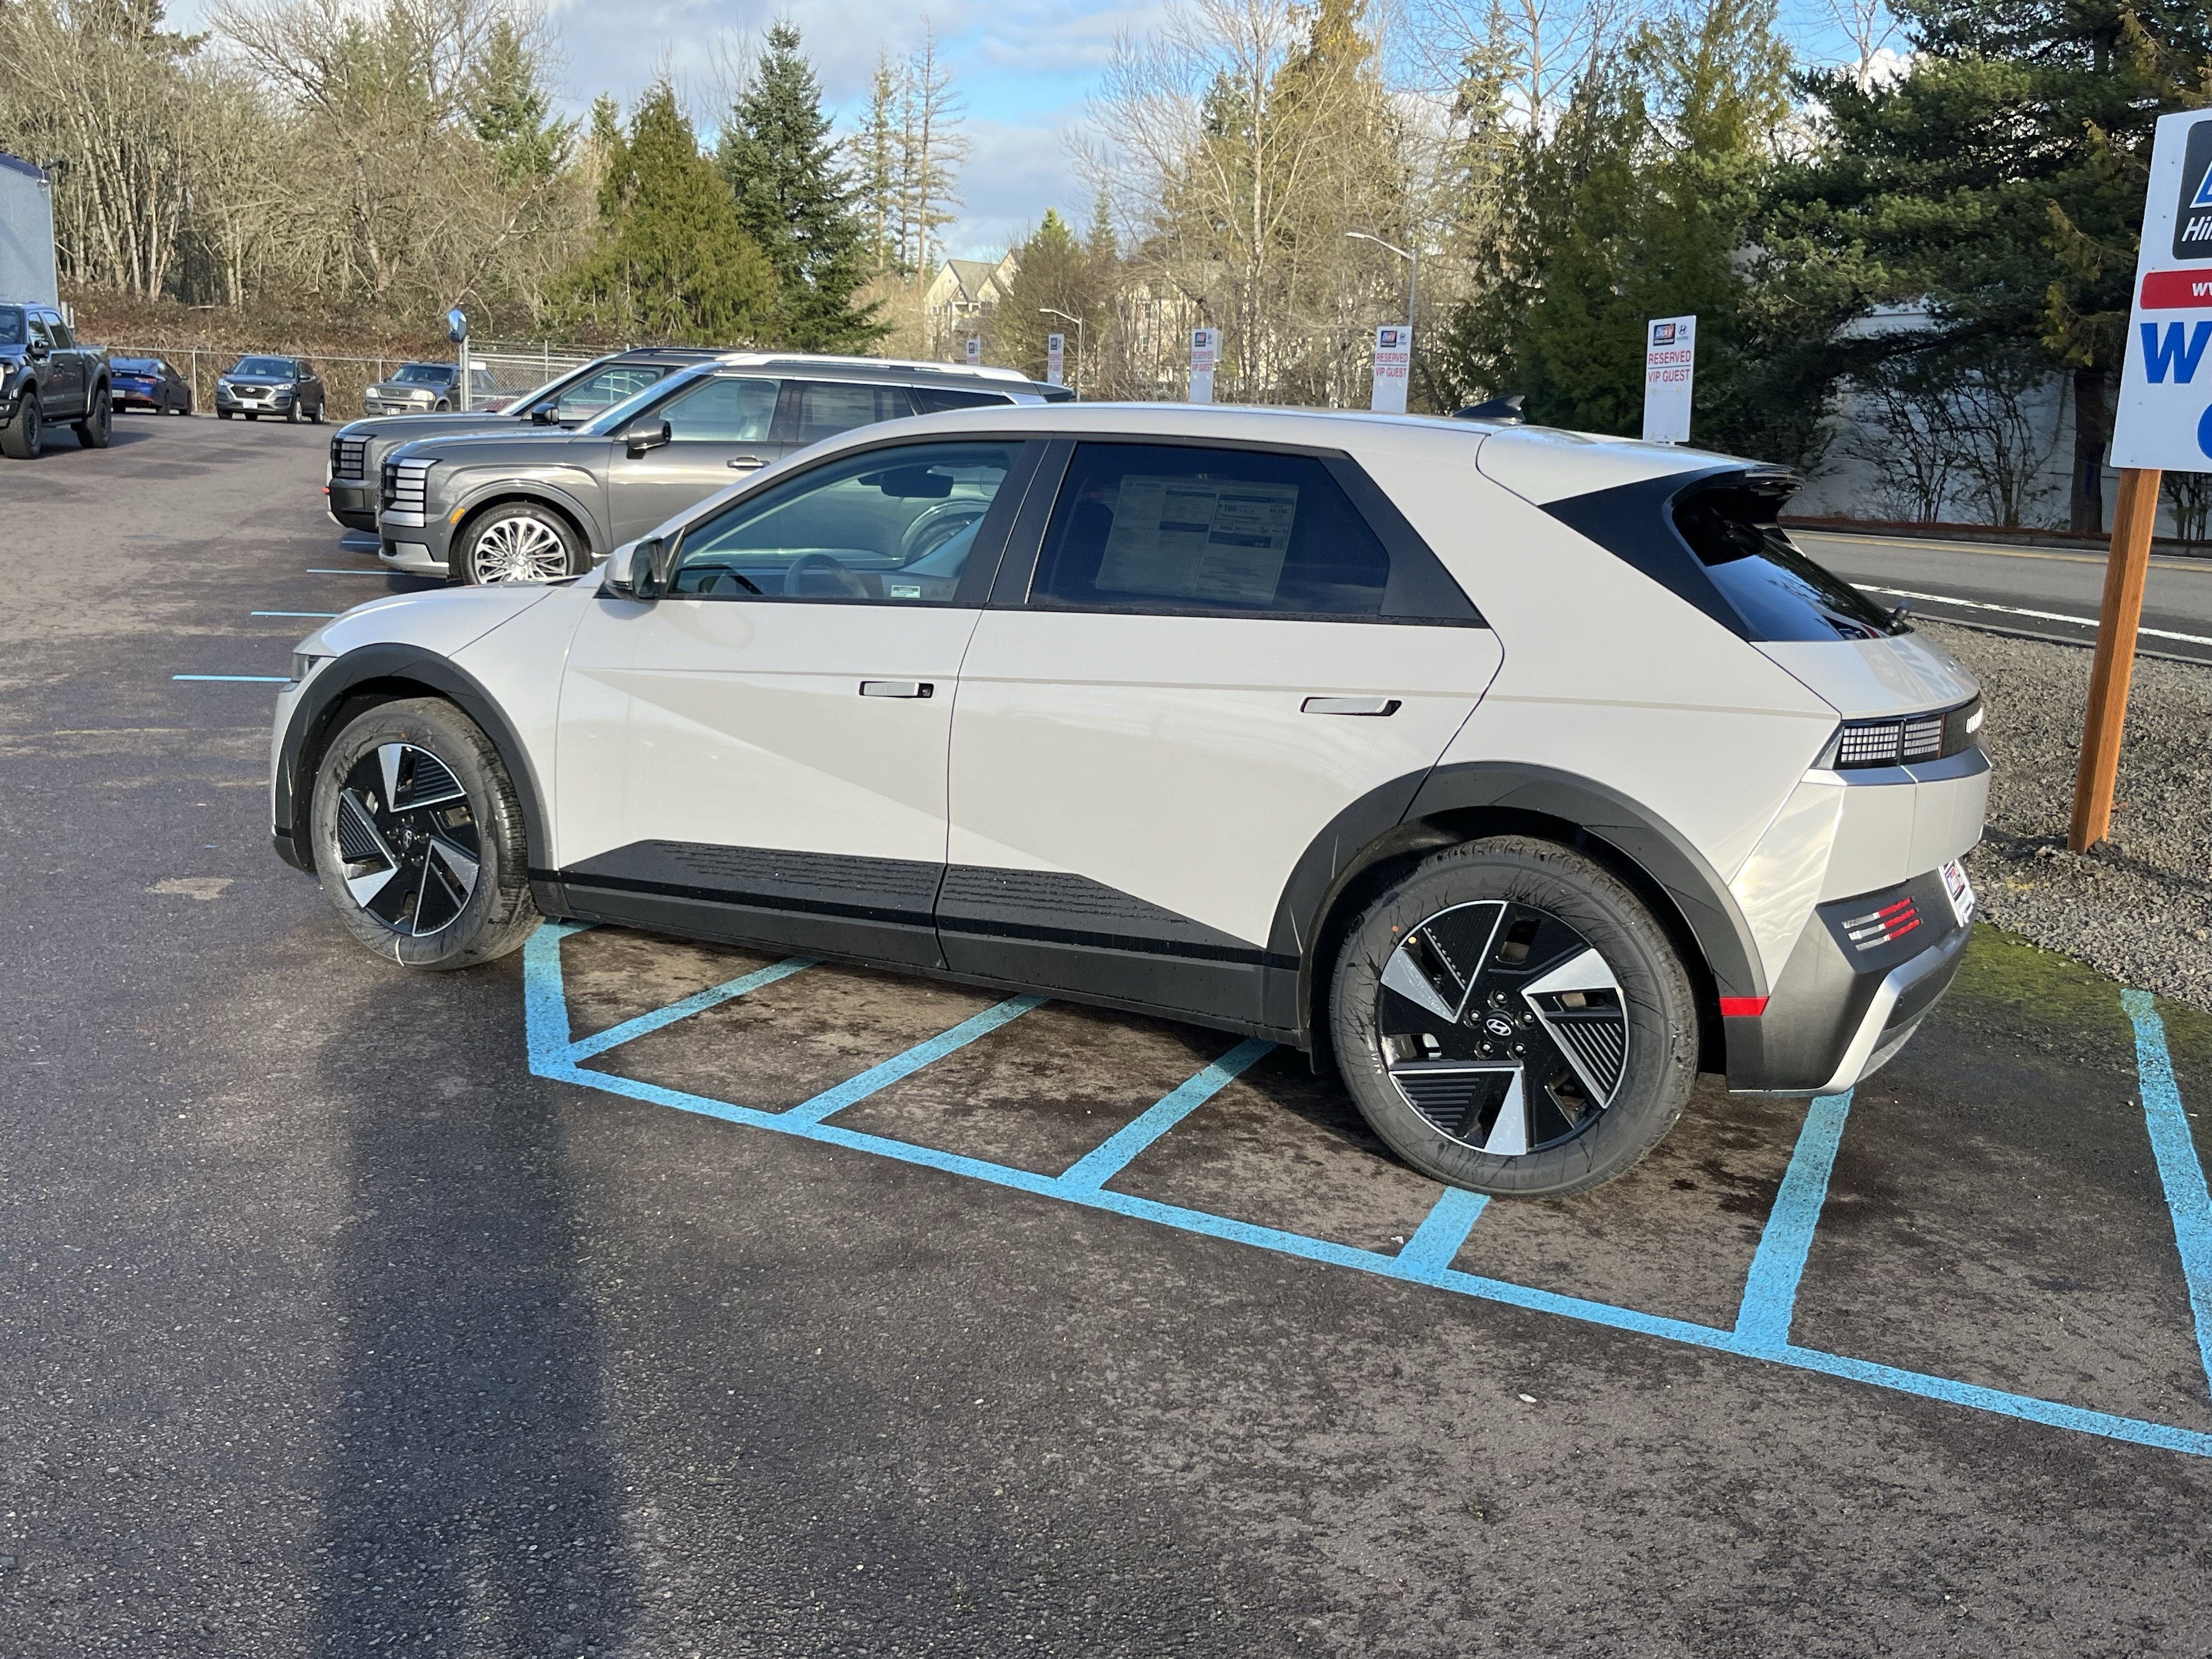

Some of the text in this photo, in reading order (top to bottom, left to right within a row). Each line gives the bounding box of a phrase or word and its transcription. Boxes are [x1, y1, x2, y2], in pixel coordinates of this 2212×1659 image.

[2181, 216, 2212, 241] Hil
[1376, 353, 1408, 363] RESERVED
[1649, 351, 1691, 365] RESERVED
[1375, 367, 1407, 377] VIP GUEST
[1648, 369, 1690, 383] VIP GUEST
